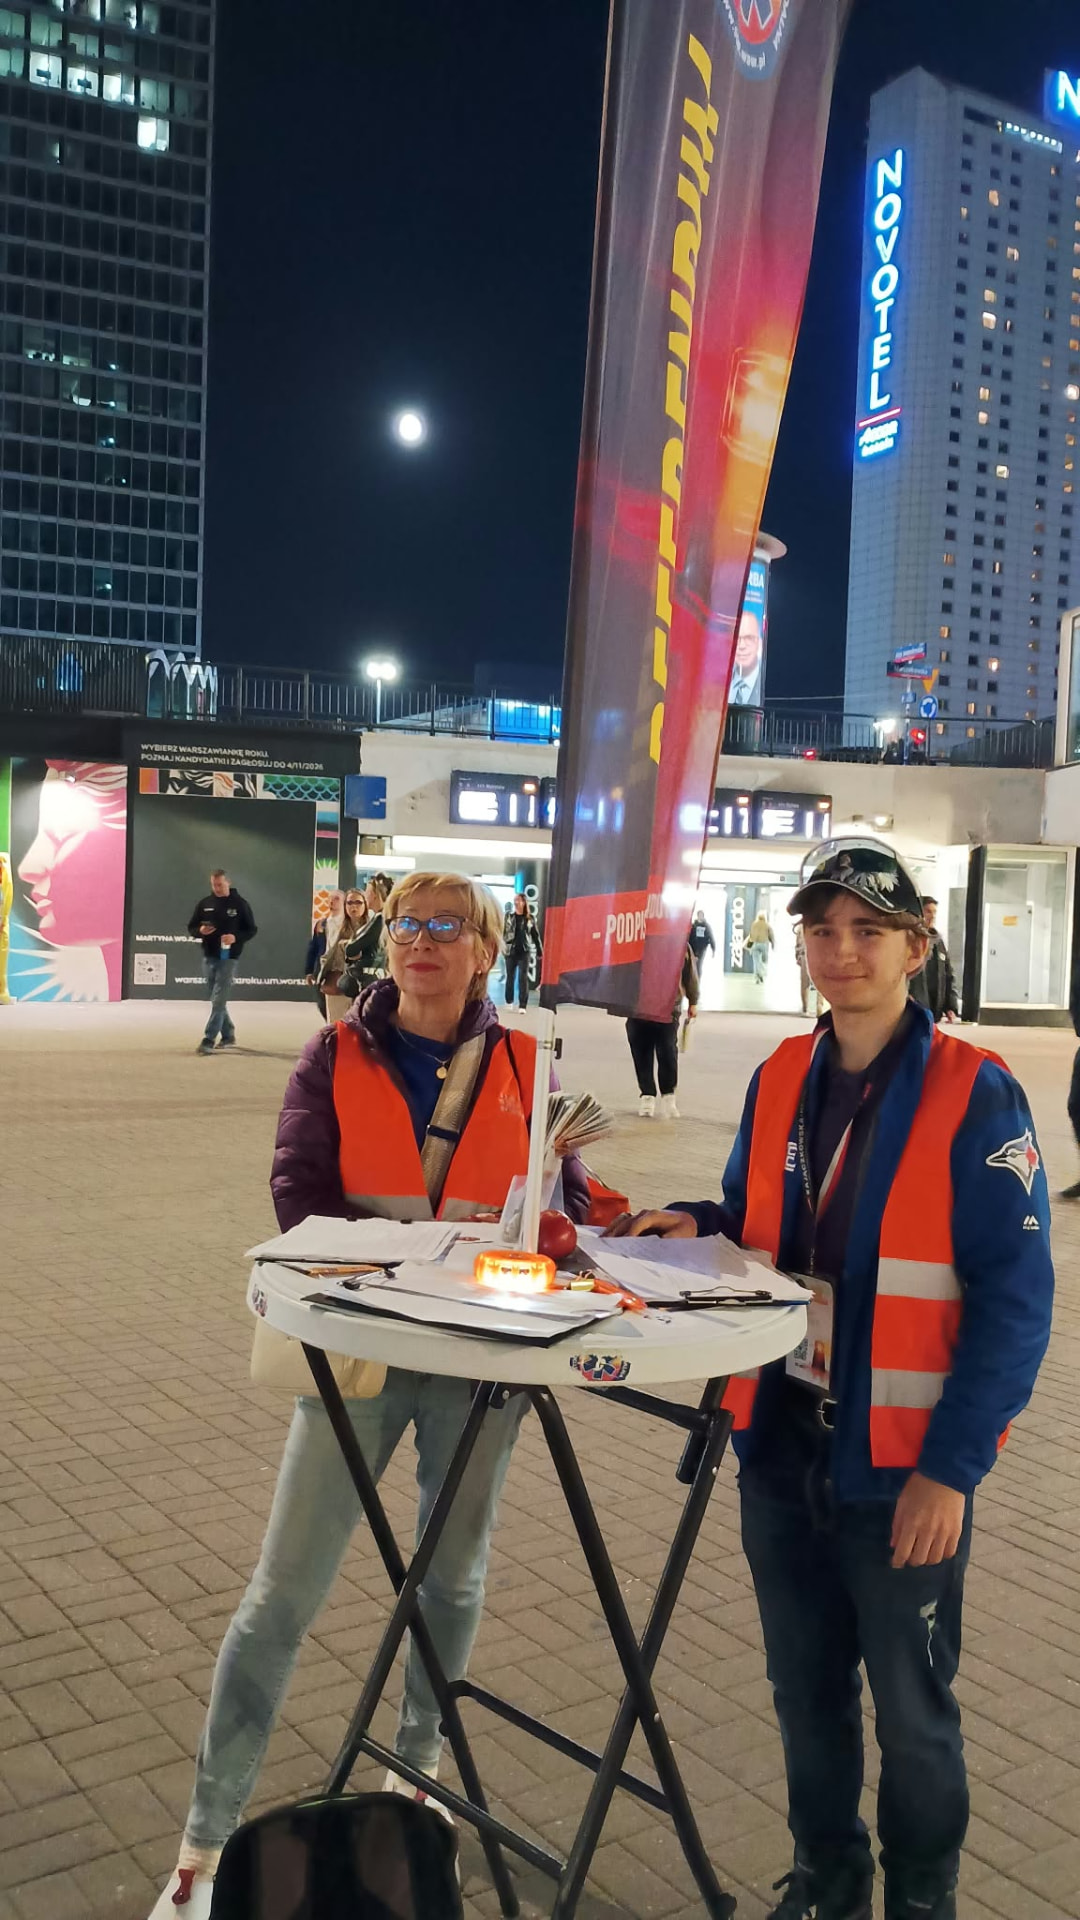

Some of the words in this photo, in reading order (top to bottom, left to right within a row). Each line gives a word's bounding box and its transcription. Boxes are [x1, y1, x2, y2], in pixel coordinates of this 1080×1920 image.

[869, 148, 903, 411] NOVOTEL
[140, 744, 178, 753] WYBIERZ
[140, 753, 174, 762] POZNAJ
[273, 760, 286, 769] DO
[729, 896, 746, 969] zalando
